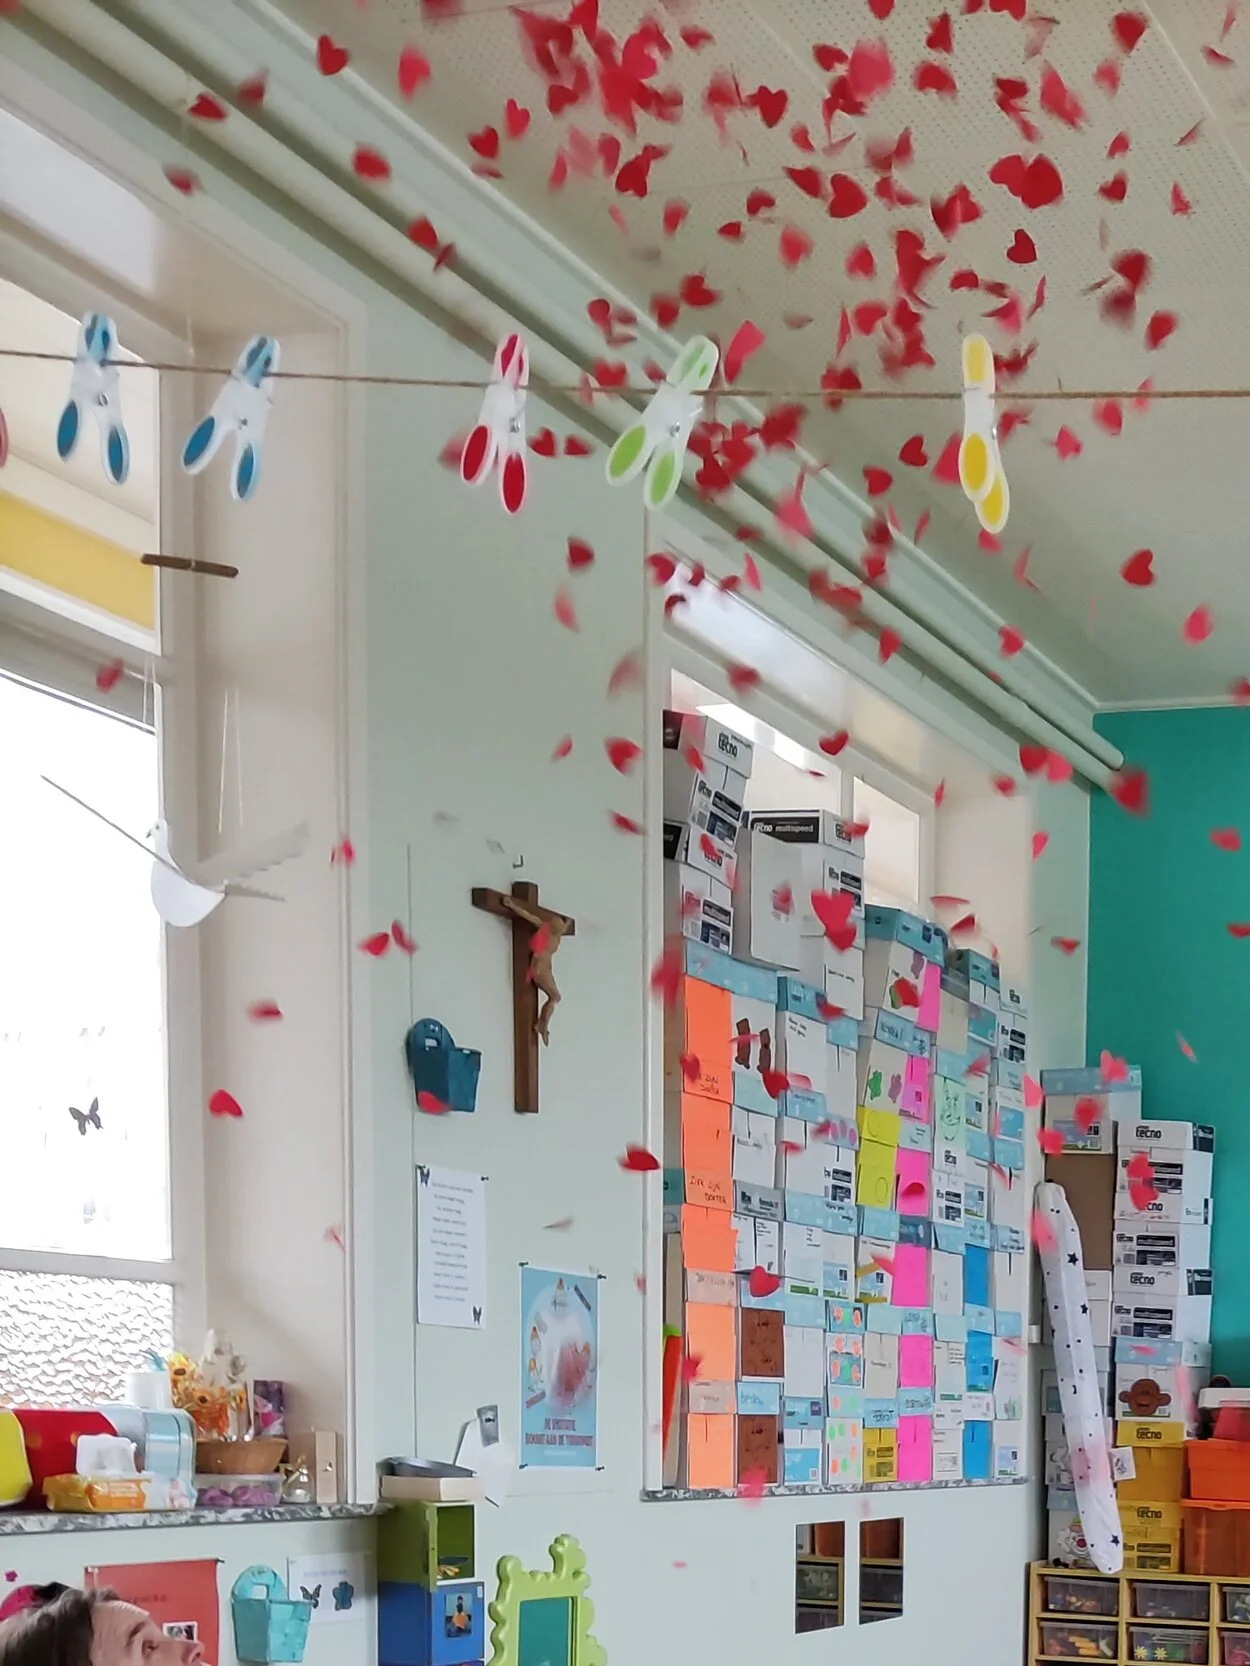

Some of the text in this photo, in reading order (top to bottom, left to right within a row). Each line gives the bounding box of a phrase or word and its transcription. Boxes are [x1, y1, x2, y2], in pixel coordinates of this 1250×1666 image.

[1135, 1125, 1162, 1139] tecno
[1146, 1202, 1163, 1212] cno
[1129, 1271, 1156, 1286] tecno
[1136, 1426, 1162, 1440] tecno
[1136, 1506, 1163, 1519] tecno
